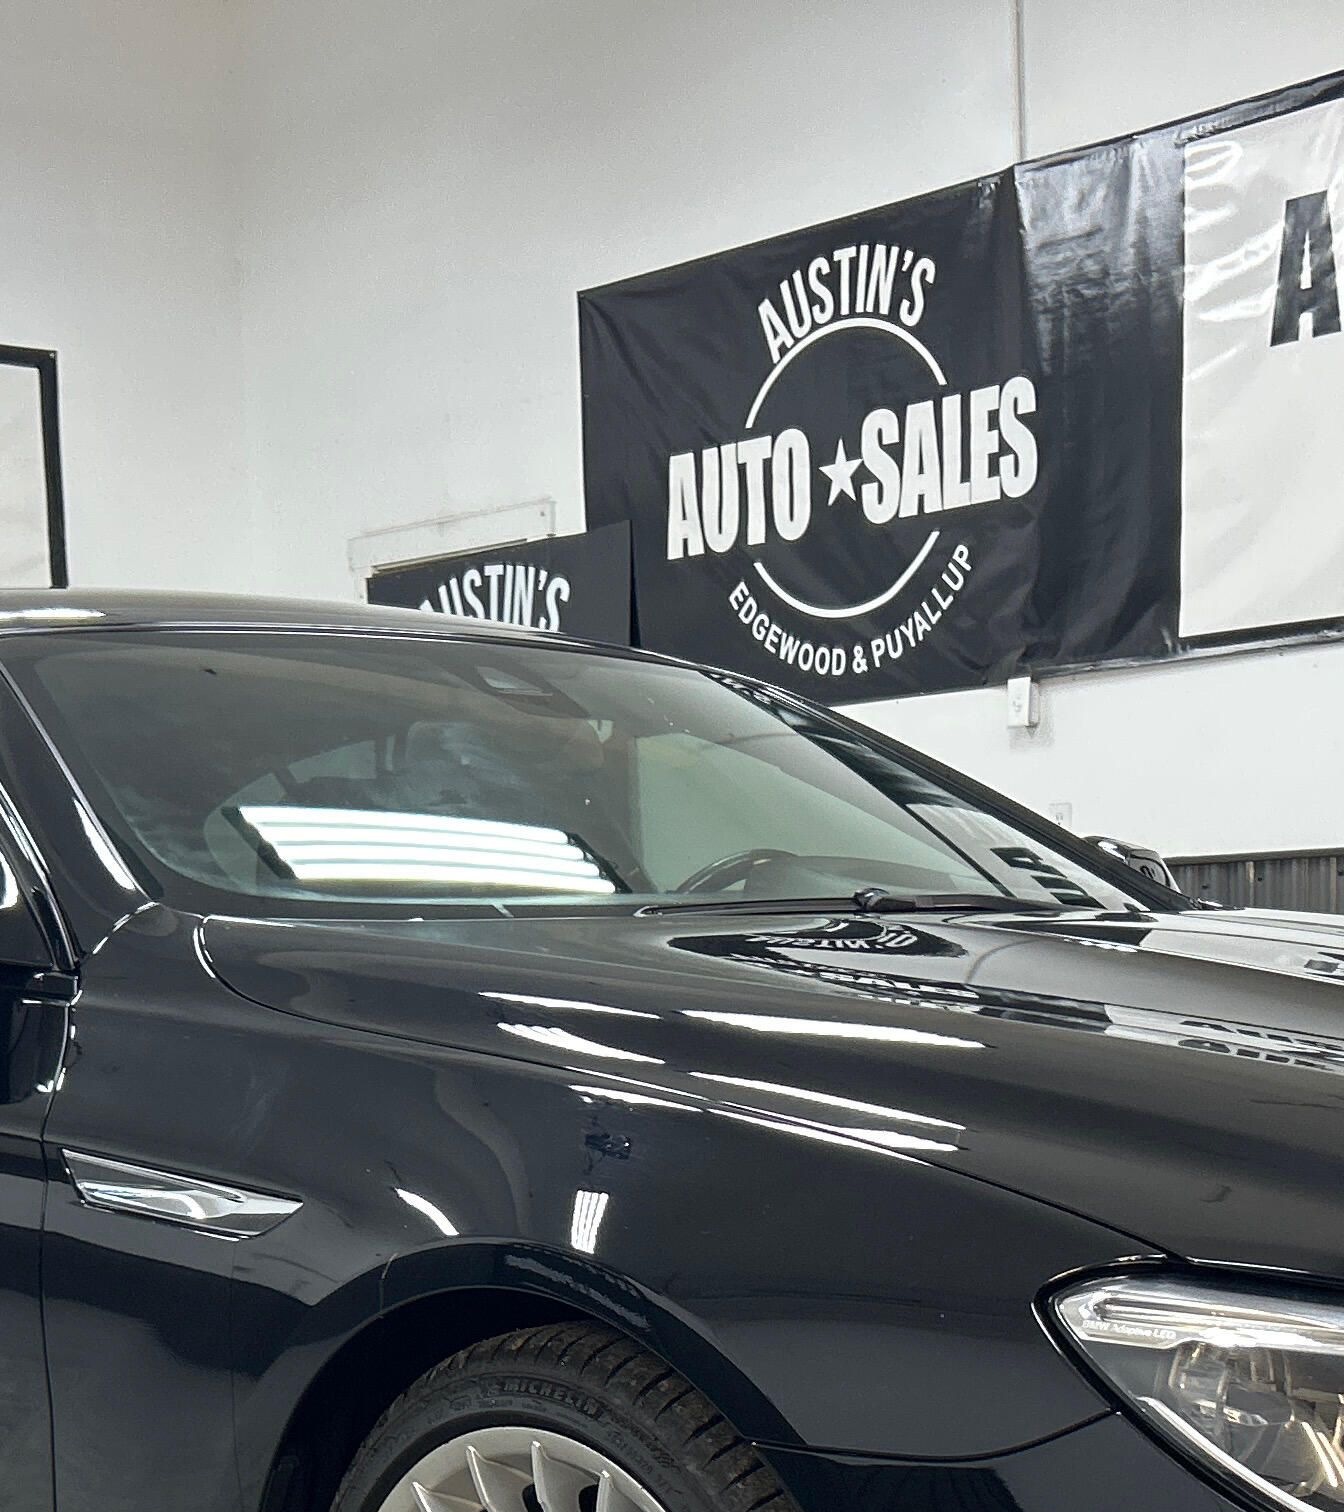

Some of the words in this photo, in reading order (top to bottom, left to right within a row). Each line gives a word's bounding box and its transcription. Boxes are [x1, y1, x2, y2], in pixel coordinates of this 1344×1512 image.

[757, 243, 937, 364] AUSTIN'S
[667, 428, 811, 561] AUTO
[861, 375, 1038, 525] SALES
[419, 563, 571, 633] USTIN'S
[729, 581, 847, 676] EDGEWOOD
[851, 644, 869, 675] &
[870, 544, 973, 669] PUYALLUP
